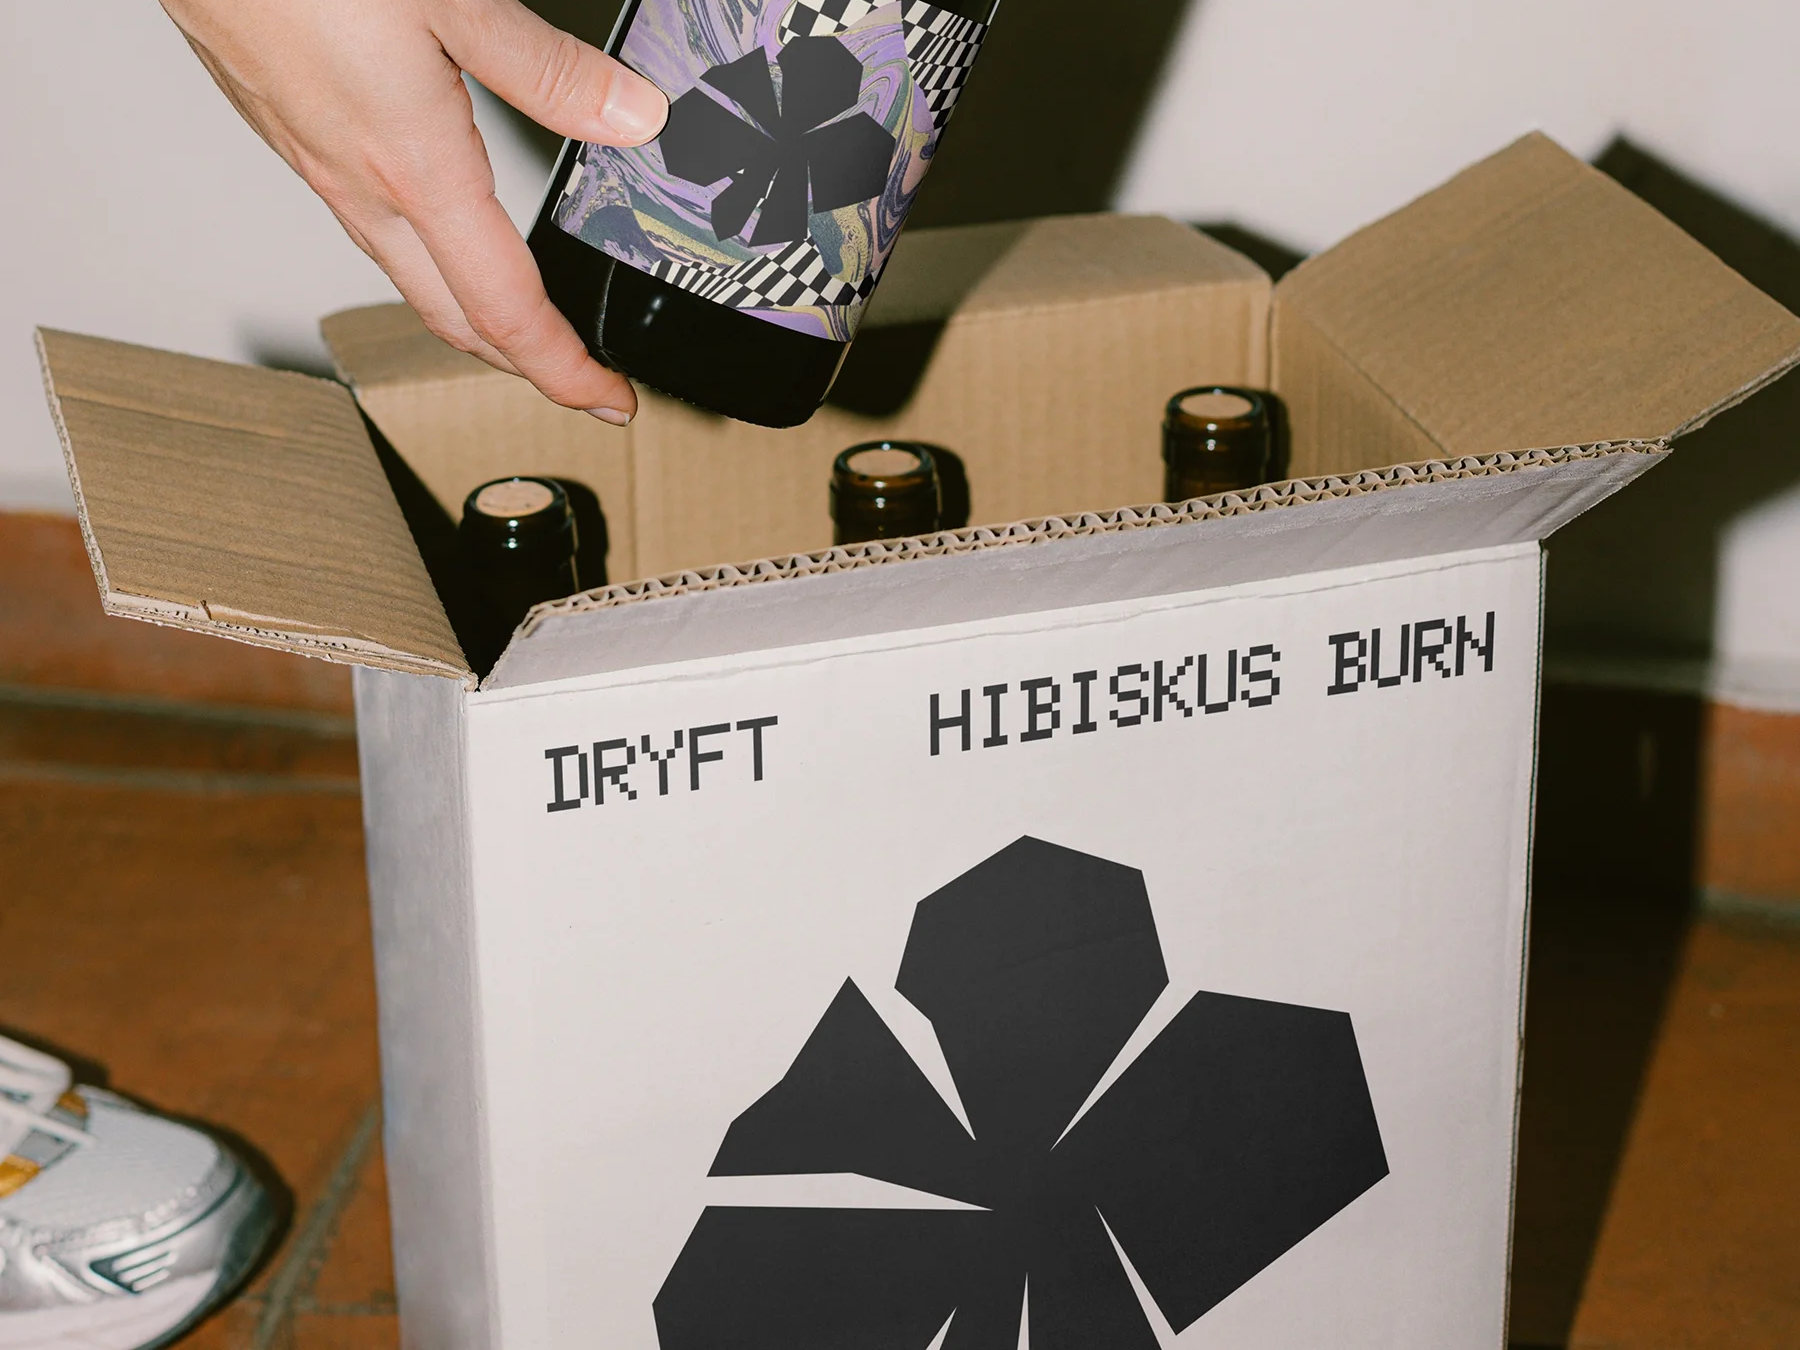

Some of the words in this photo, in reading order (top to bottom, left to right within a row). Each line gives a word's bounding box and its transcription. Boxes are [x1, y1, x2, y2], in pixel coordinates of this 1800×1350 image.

[930, 644, 1281, 756] HIBISKUS
[1327, 611, 1495, 696] BURN
[544, 715, 778, 813] DRYFT
